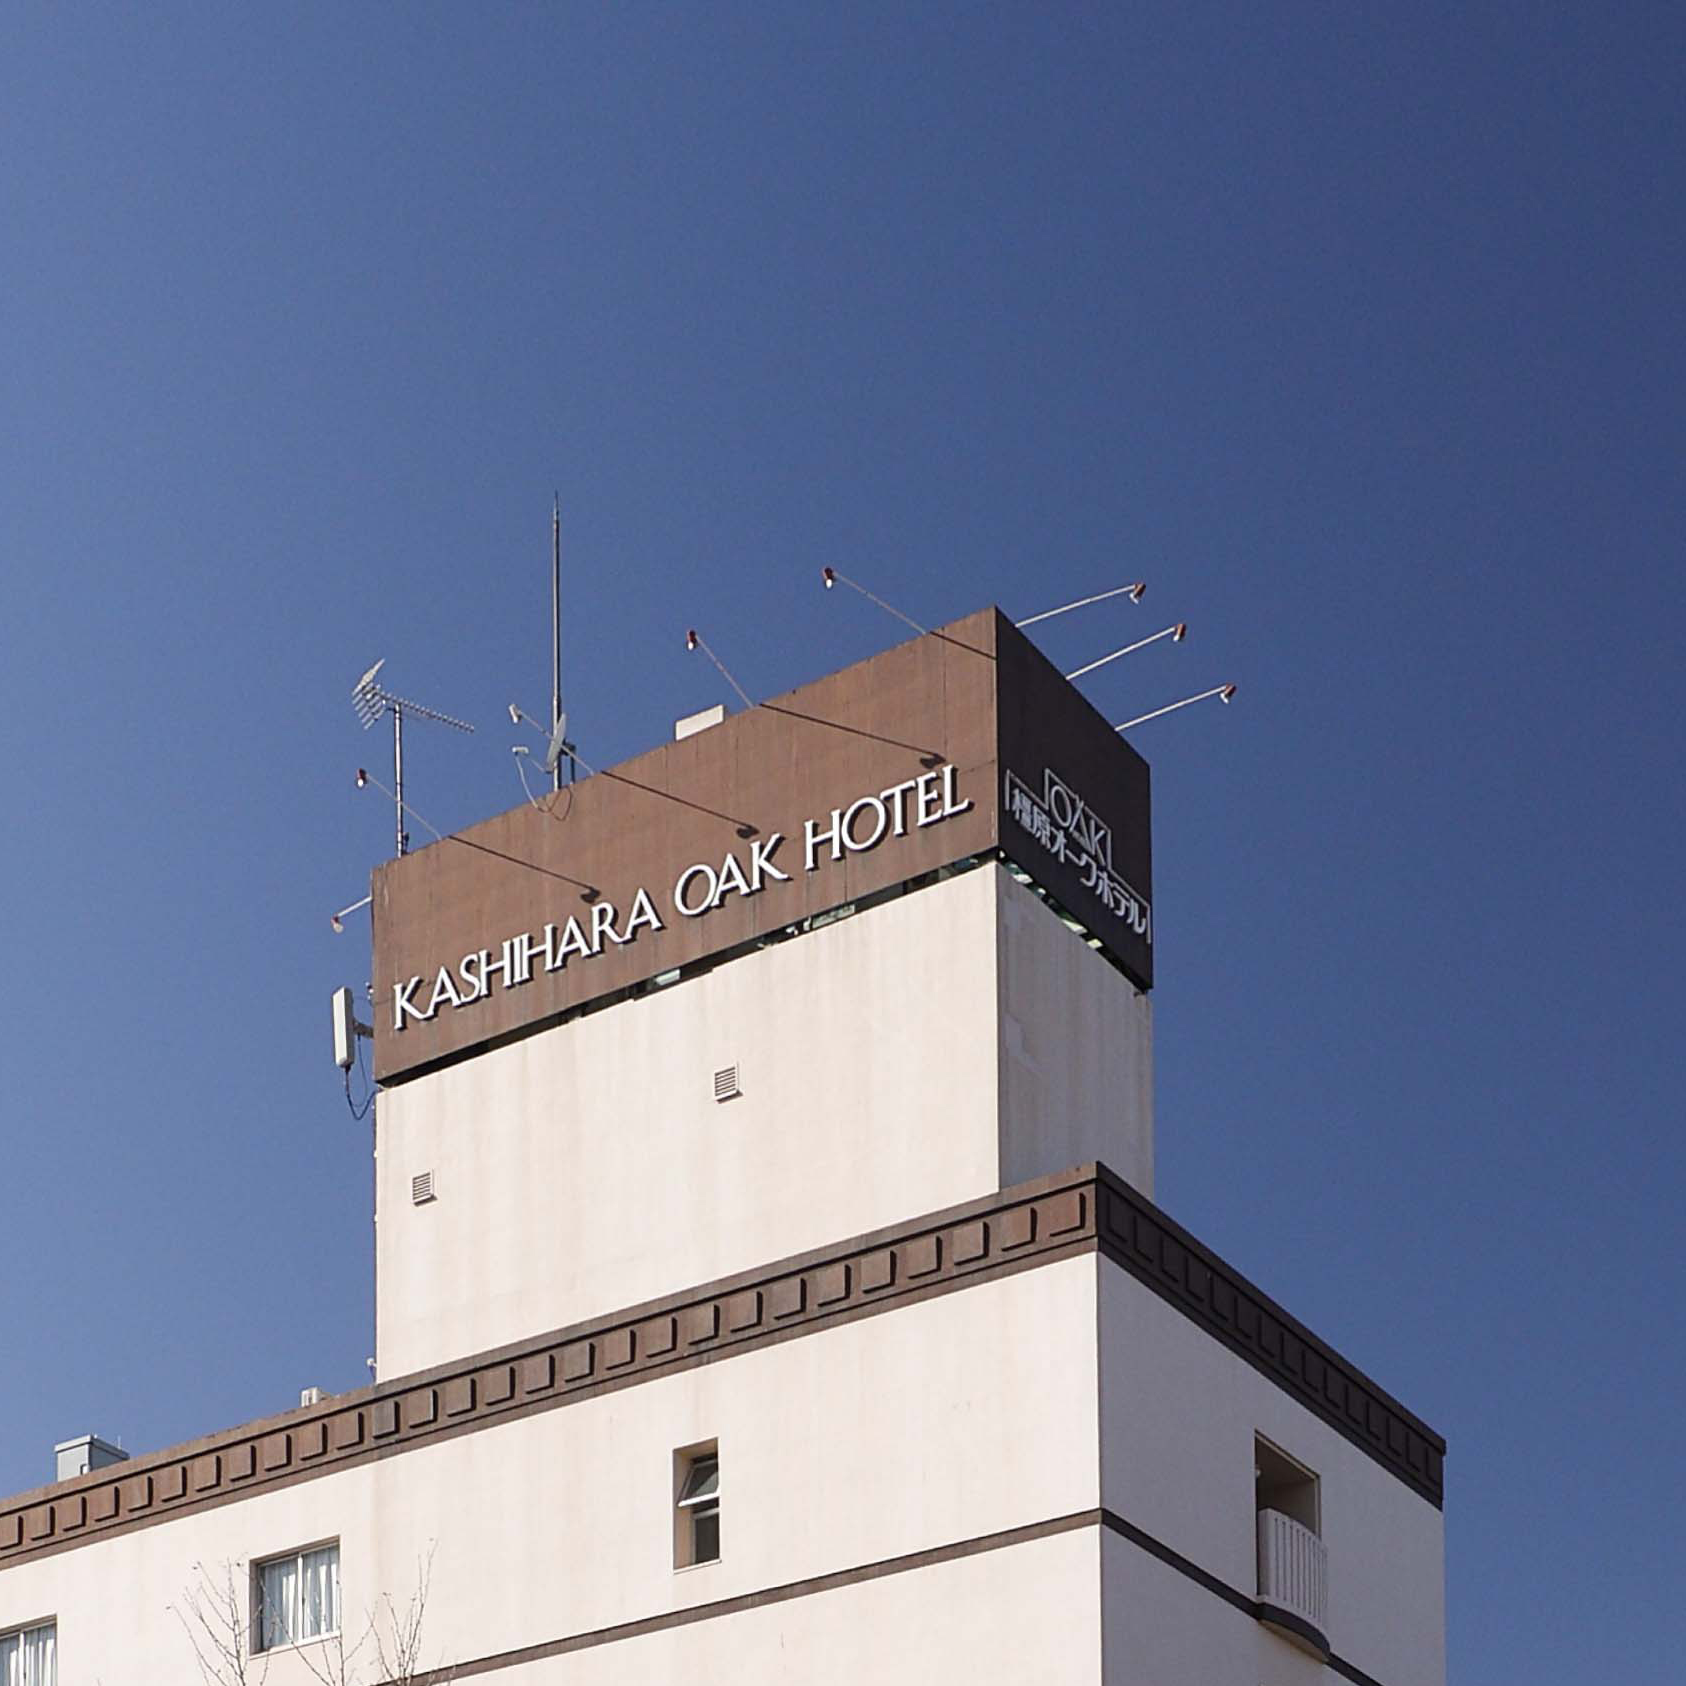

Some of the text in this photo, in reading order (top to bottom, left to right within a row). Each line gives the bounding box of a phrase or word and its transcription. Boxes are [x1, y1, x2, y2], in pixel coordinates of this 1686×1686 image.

[393, 764, 971, 1030] KASHIHARA OAK HOTEL
[1011, 787, 1147, 935] 橿原オークホテル
